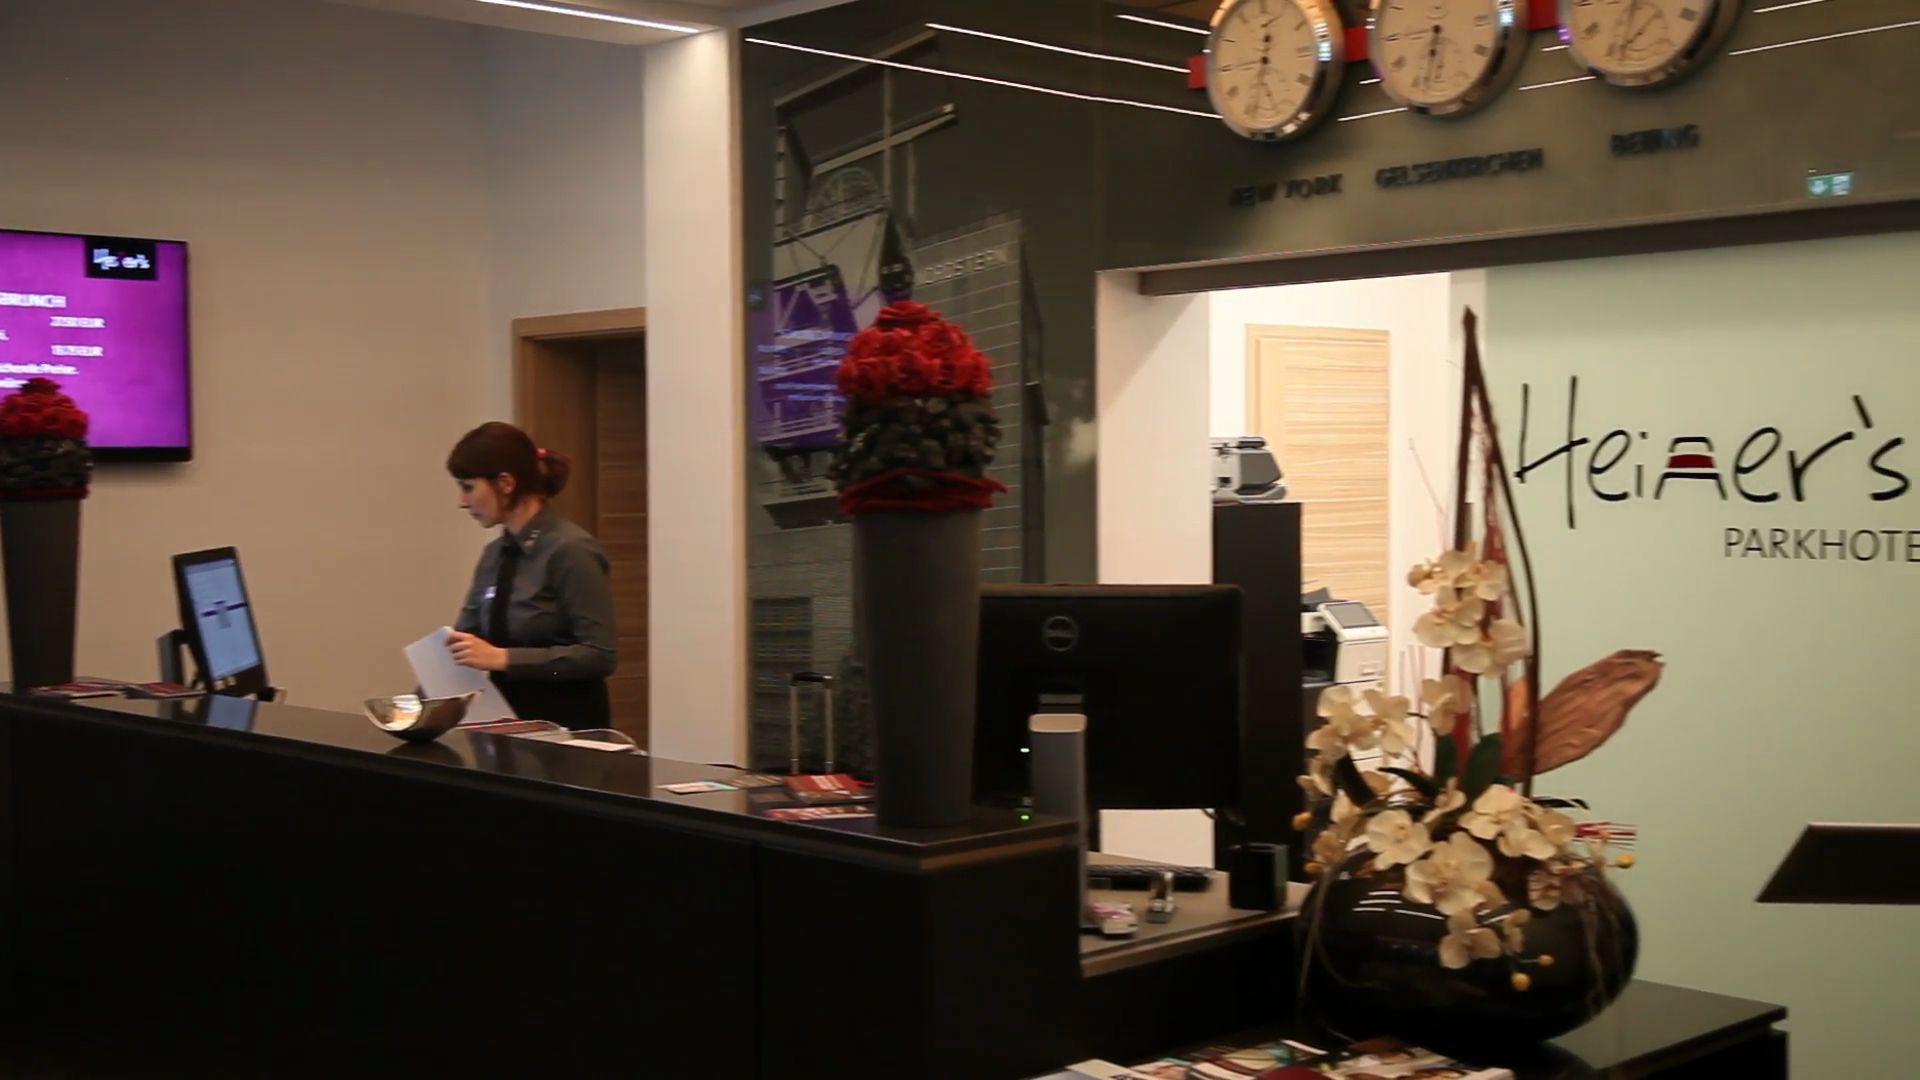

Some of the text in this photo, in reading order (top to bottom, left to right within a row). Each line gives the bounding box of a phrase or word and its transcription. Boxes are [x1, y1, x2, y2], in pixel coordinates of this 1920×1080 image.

[1375, 148, 1544, 189] GELSENKIRCHEN
[1230, 173, 1343, 207] NEW YORK
